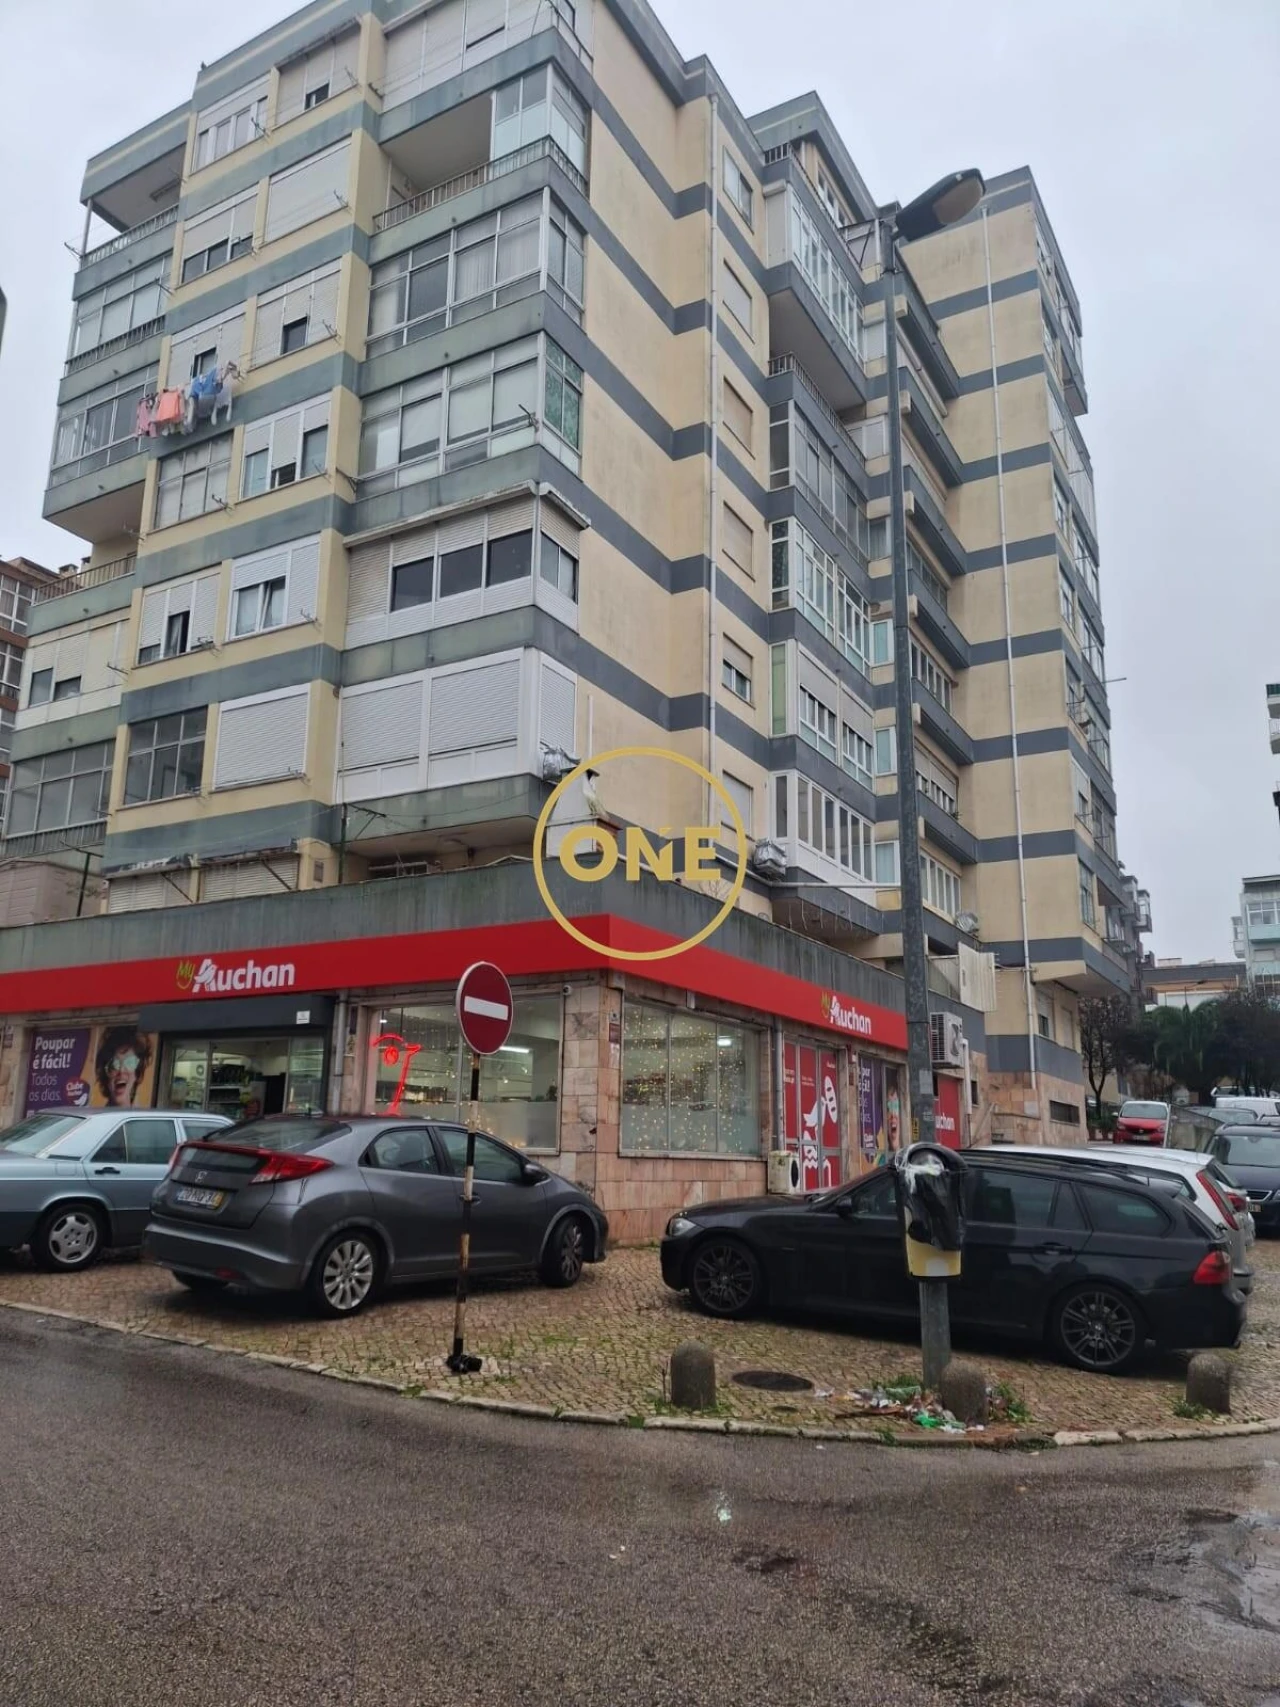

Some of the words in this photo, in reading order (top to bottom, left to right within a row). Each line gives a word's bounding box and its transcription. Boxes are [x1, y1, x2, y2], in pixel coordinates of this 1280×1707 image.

[176, 960, 195, 990] My
[192, 958, 296, 993] Auchan
[830, 995, 872, 1035] Auchan
[35, 1036, 76, 1054] Poupar
[32, 1054, 40, 1070] é
[41, 1053, 72, 1070] fácil!
[32, 1072, 58, 1086] Todos
[28, 1091, 40, 1102] os
[41, 1088, 62, 1102] dias.
[935, 1112, 956, 1132] uchan
